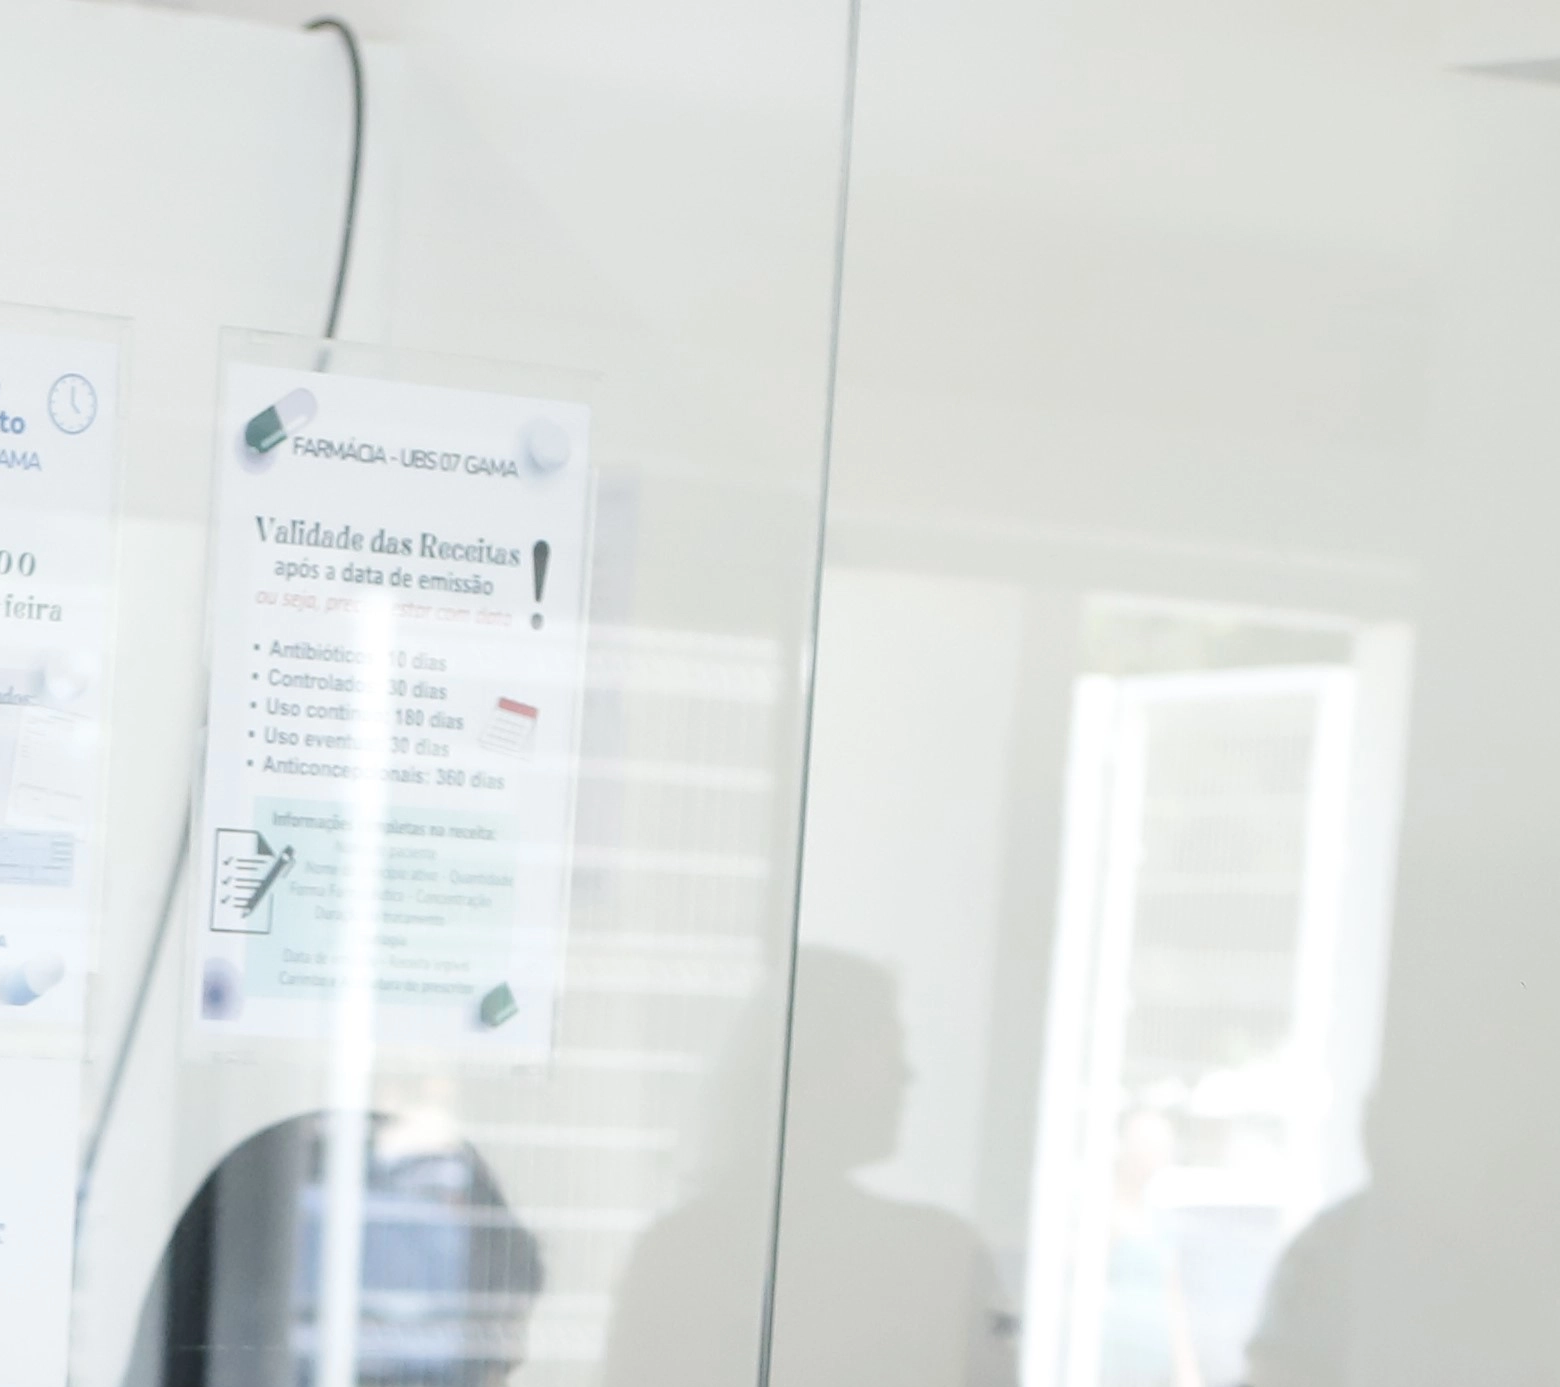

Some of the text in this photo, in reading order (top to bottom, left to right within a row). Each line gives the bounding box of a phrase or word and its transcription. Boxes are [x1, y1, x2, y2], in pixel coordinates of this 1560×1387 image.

[293, 436, 388, 464] FARMÁCIA
[401, 448, 437, 471] UBS
[440, 451, 462, 472] 07
[465, 454, 520, 479] GAMA
[254, 514, 521, 566] Validade das Receitas
[273, 557, 495, 597] após a data de emissão
[412, 652, 447, 672] dias
[412, 681, 448, 701] dias
[265, 696, 301, 717] Uso
[395, 708, 424, 727] 180
[430, 711, 464, 730] dias
[263, 726, 300, 746] Uso
[415, 737, 450, 757] dias
[436, 768, 466, 786] 360
[471, 771, 506, 790] dias
